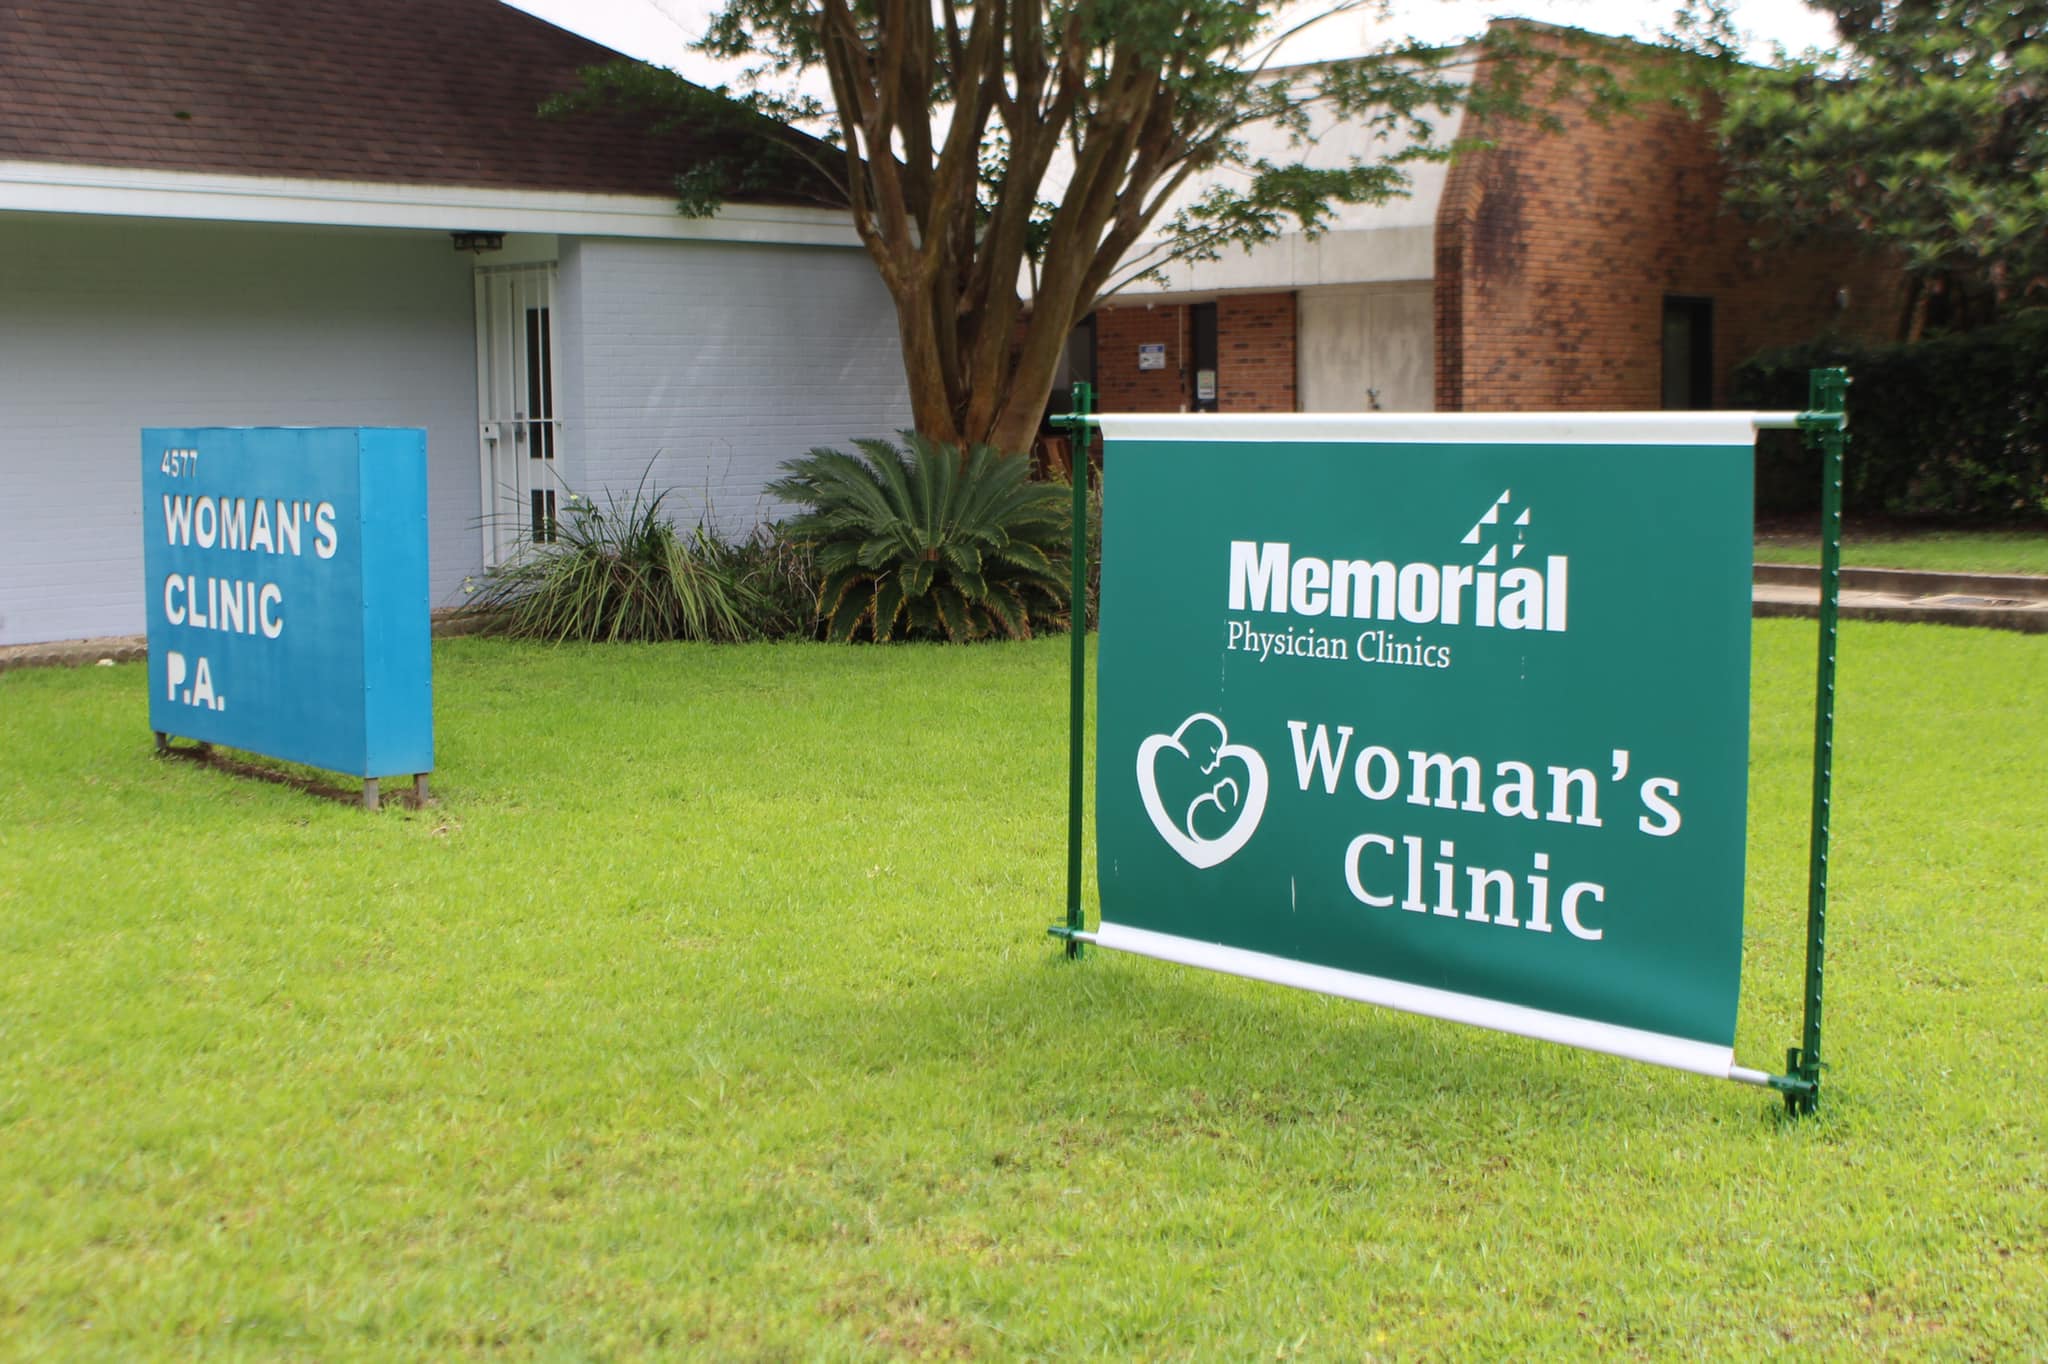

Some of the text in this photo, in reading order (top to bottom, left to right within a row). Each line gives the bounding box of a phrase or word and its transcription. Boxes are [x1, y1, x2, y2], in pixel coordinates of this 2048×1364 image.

[160, 449, 198, 478] 4577
[163, 494, 338, 560] WOMAN'S
[164, 573, 283, 639] CLINIC
[1228, 539, 1568, 632] Memorial
[1227, 621, 1451, 668] Physician Clinics
[166, 651, 225, 712] P.A.
[1287, 720, 1682, 837] Woman's
[1344, 833, 1606, 941] Clinic
